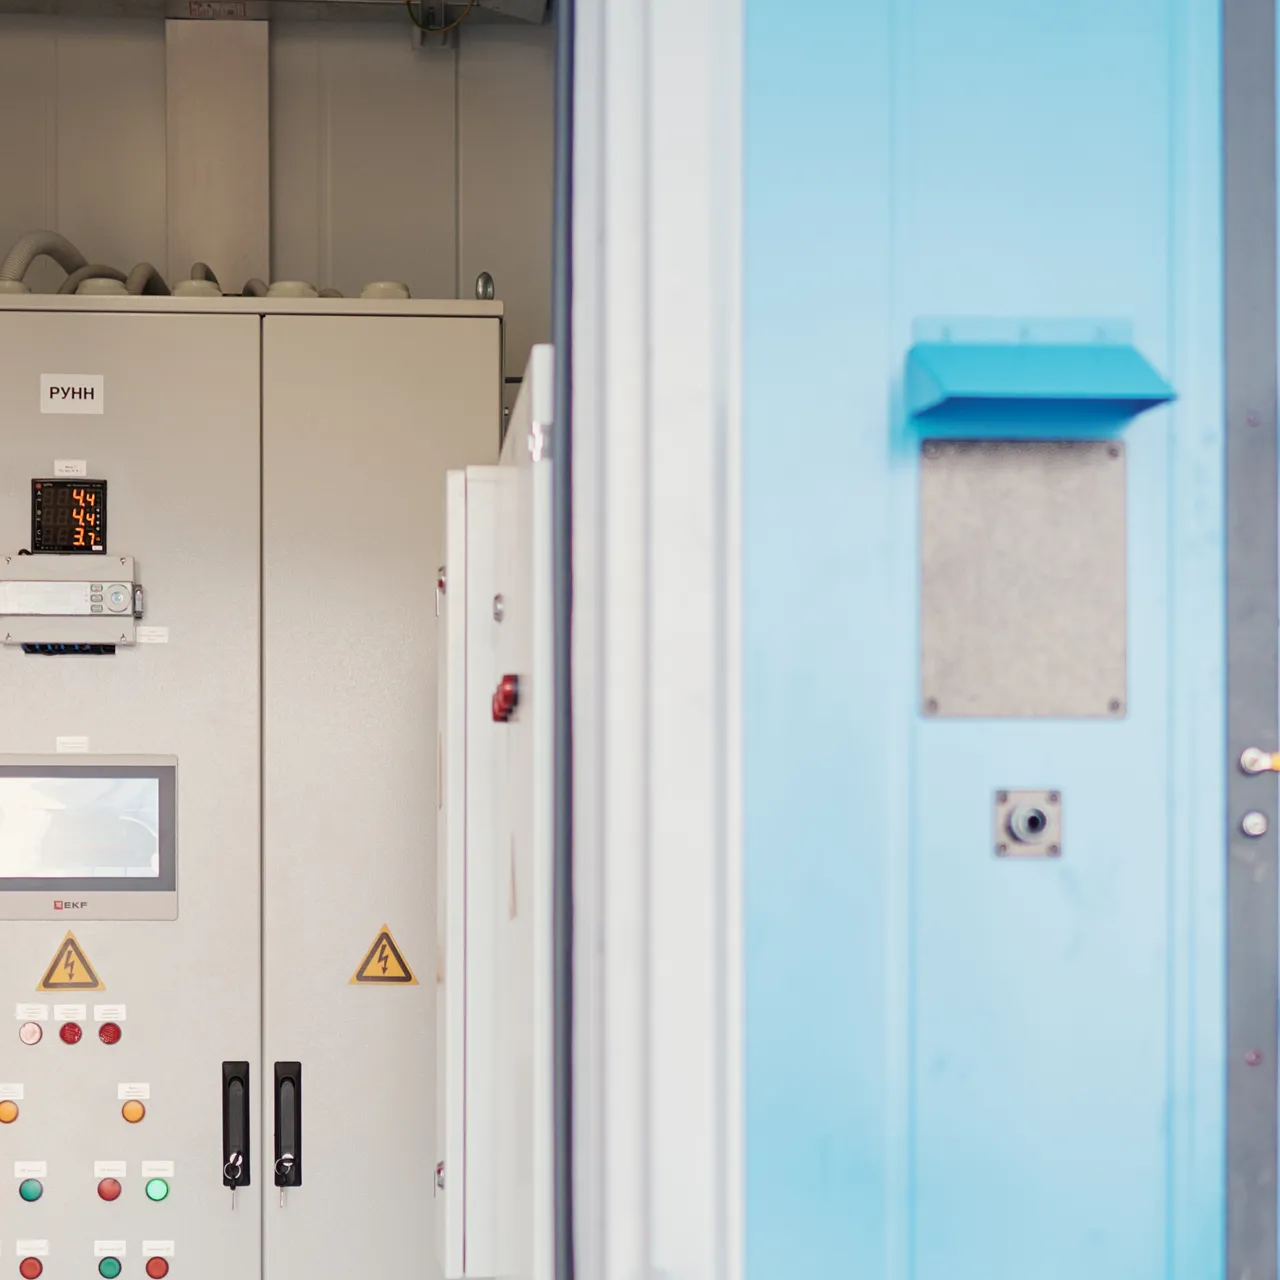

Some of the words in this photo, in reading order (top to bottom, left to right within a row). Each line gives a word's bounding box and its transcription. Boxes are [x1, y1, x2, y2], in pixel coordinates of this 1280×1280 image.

[49, 386, 95, 400] РУНН
[72, 488, 96, 507] 4.4
[72, 508, 96, 527] 4.4
[64, 901, 88, 909] EKF
